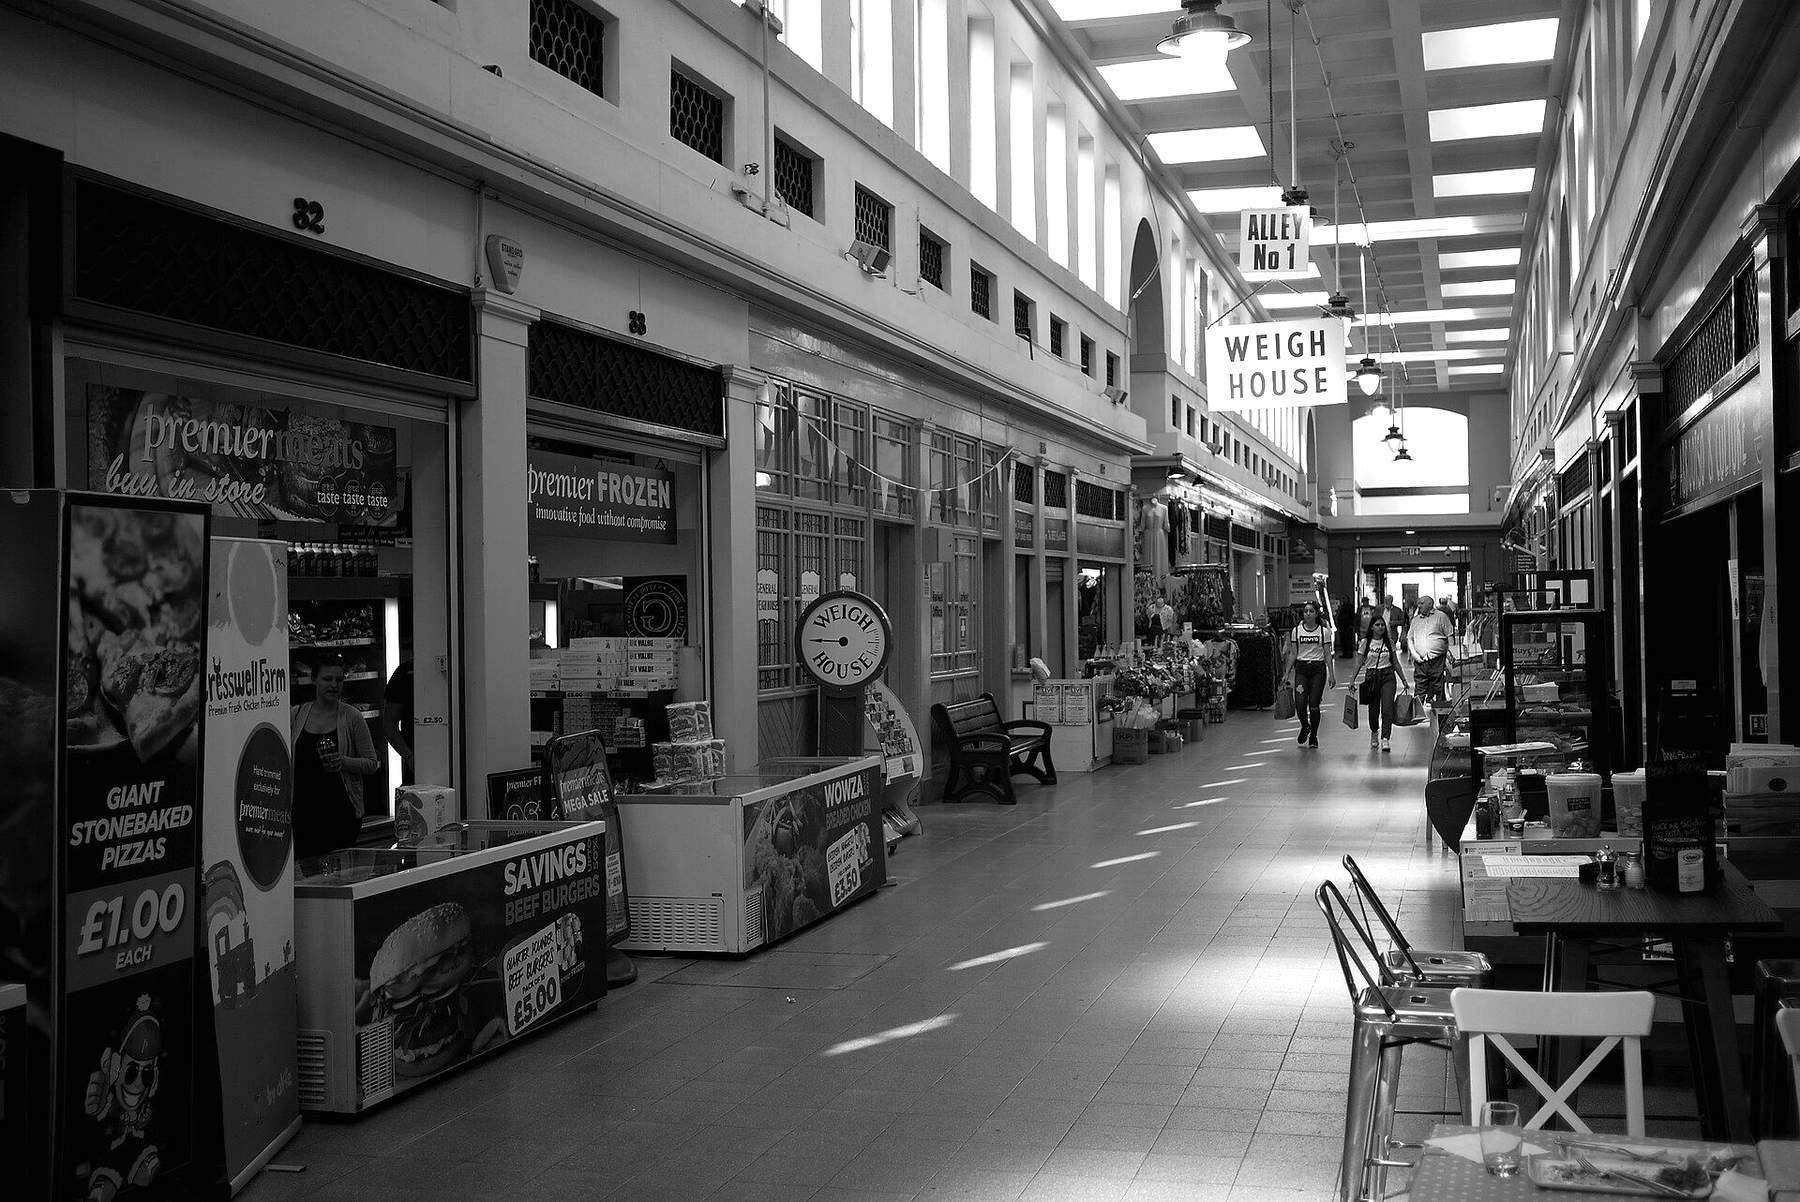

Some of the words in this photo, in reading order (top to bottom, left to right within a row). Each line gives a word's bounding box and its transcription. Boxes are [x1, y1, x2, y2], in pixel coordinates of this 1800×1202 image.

[1248, 213, 1303, 241] ALLEY
[1253, 243, 1279, 270] No
[1287, 243, 1295, 270] 1
[1224, 329, 1326, 363] WEIGH
[1229, 367, 1328, 399] HOUSE
[106, 452, 158, 497] buy
[167, 470, 197, 499] in
[203, 473, 266, 505] store
[527, 463, 594, 504] premier
[597, 471, 671, 509] FROZEN
[317, 491, 340, 504] taste
[343, 492, 365, 506] taste
[367, 494, 388, 507] taste
[535, 504, 577, 524] innovative
[578, 506, 596, 527] food
[597, 509, 626, 527] without
[627, 516, 667, 533] compromise
[813, 604, 874, 631] WEIGH
[205, 660, 258, 702] resswell
[259, 658, 286, 694] Farm
[813, 651, 874, 679] HOUSE
[228, 701, 242, 714] Fresh
[106, 780, 165, 811] GIANT
[563, 794, 588, 814] MEGA
[588, 789, 609, 807] SALE
[824, 774, 864, 808] WOWZA
[69, 804, 193, 847] STONEBAKED
[101, 837, 168, 871] PIZZAS
[504, 841, 587, 895] SAVINGS
[505, 893, 540, 926] BEEF
[541, 873, 600, 913] BURGERS
[77, 883, 185, 956] £1.00
[115, 945, 153, 970] EACH
[506, 944, 530, 972] QUARTER
[530, 930, 555, 957] POUNDER
[508, 968, 525, 992] BEEF
[526, 947, 555, 980] BURGERS
[513, 976, 557, 1031] £5.00
[522, 982, 534, 995] PACK
